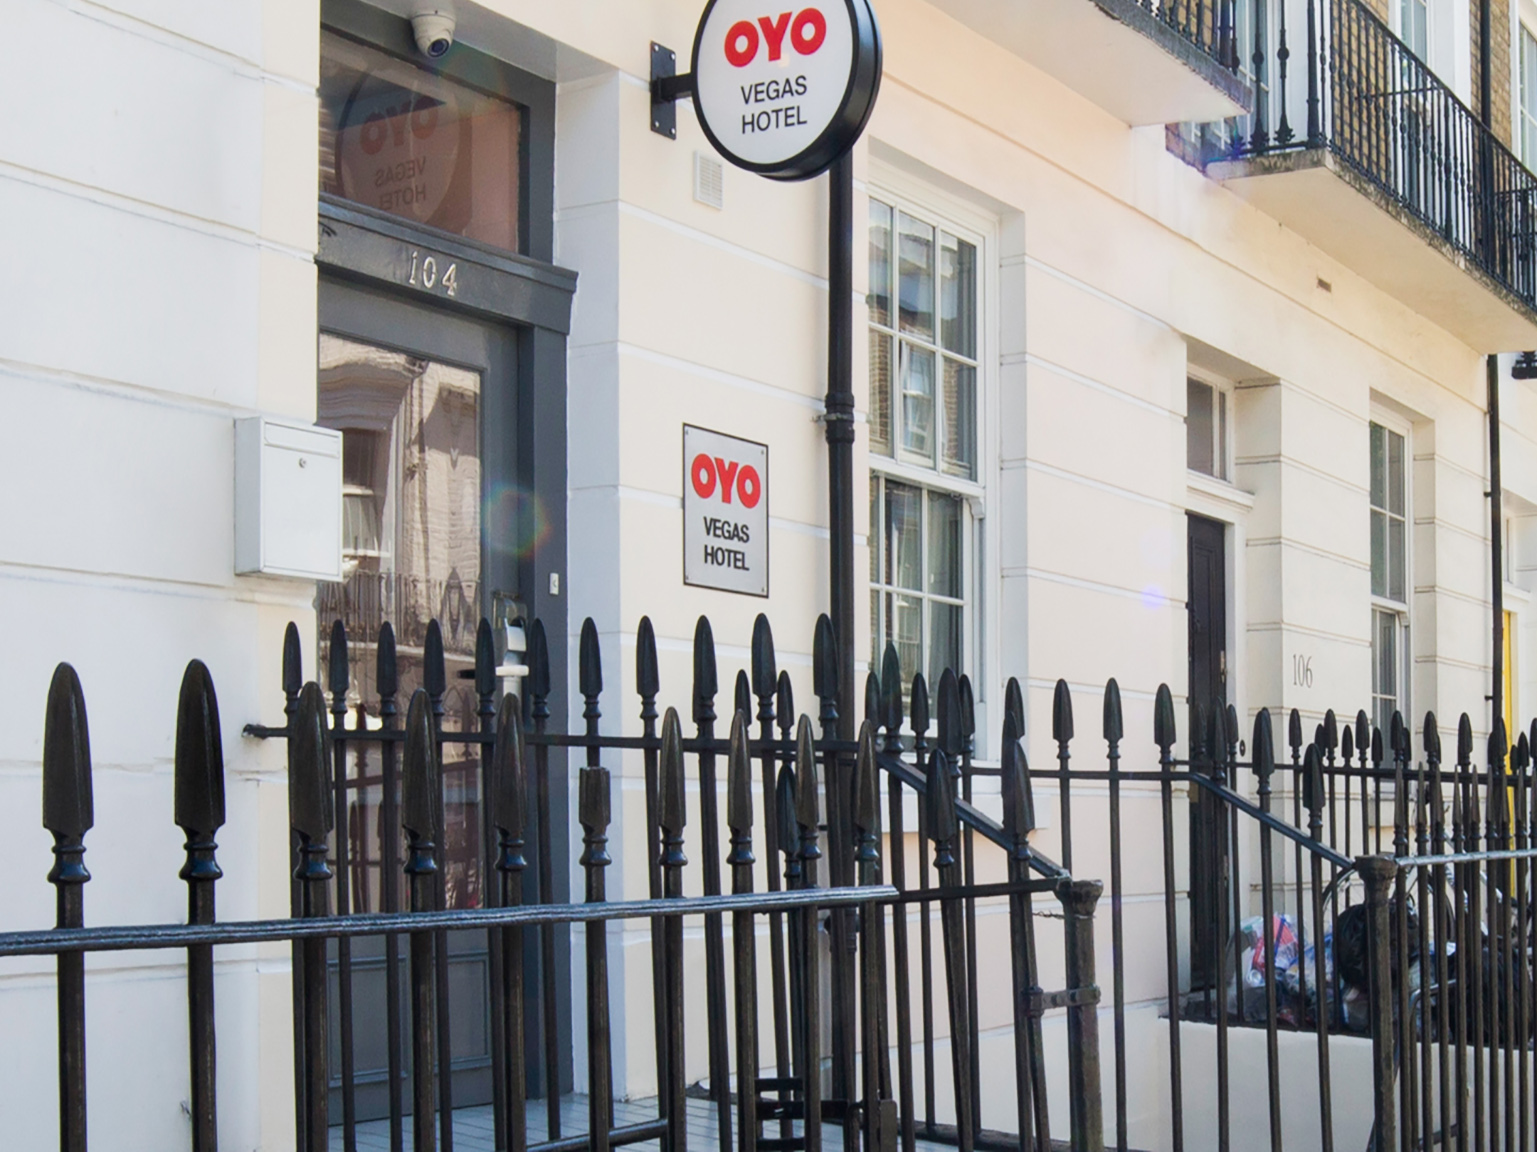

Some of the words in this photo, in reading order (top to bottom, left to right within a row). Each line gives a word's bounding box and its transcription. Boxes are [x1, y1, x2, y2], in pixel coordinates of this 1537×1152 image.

[724, 7, 827, 68] OYO
[740, 75, 808, 105] VEGAS
[741, 106, 808, 135] HOTEL
[408, 251, 458, 296] 104
[691, 453, 761, 509] OYO
[703, 516, 750, 544] VEGAS
[704, 544, 750, 571] HOTEL
[1292, 653, 1313, 689] 106
